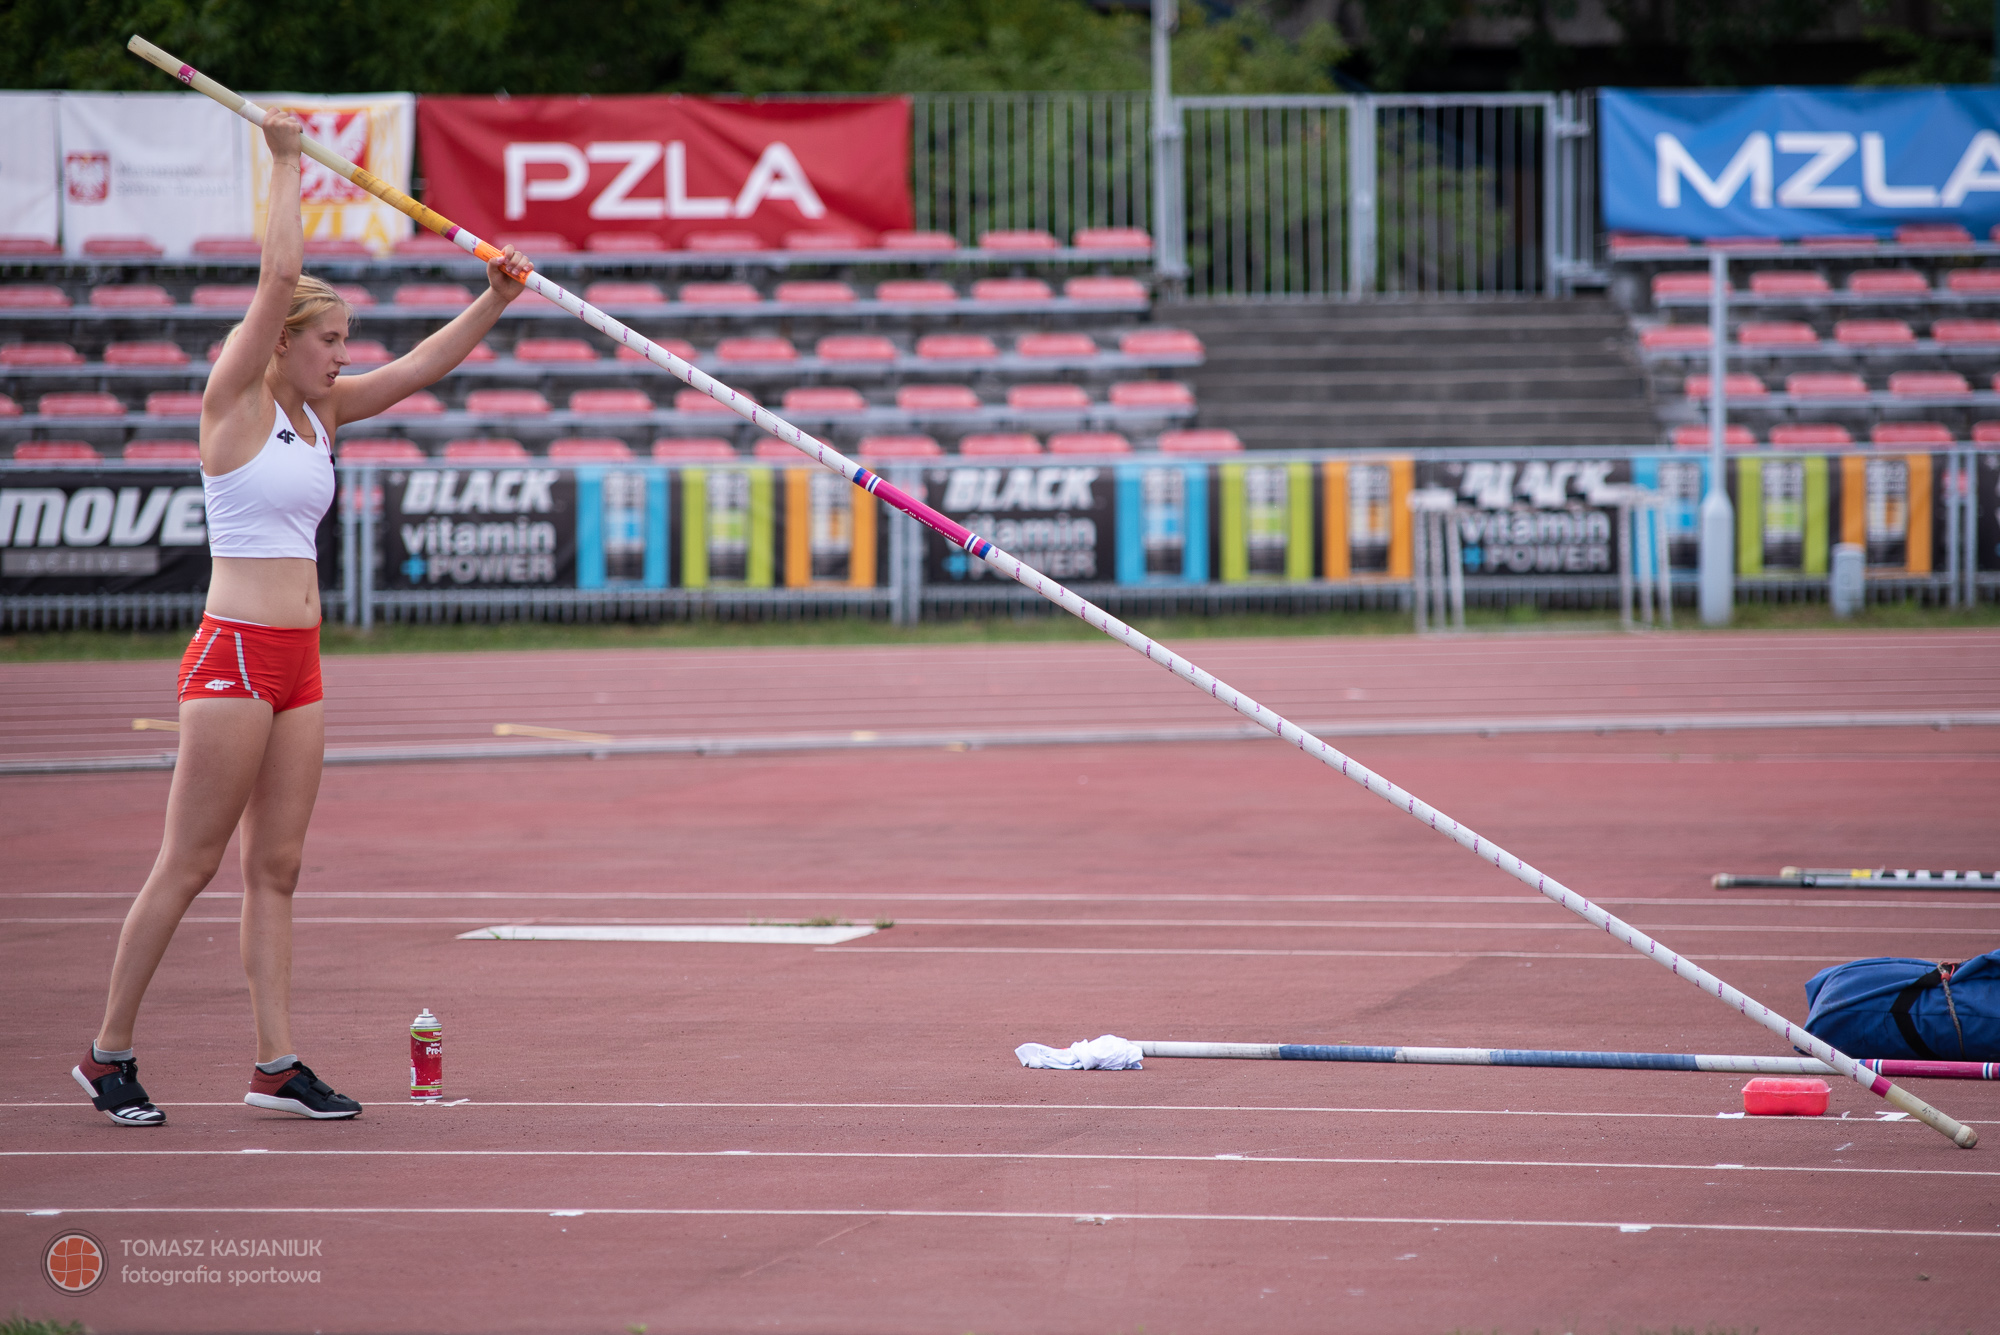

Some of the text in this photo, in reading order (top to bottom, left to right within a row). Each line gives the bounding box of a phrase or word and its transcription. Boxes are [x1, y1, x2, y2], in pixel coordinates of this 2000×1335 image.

[503, 140, 825, 221] PZLA
[1655, 130, 2000, 209] MZLA
[276, 428, 296, 445] 4F
[402, 468, 560, 514] BLACK
[942, 467, 1099, 513] BLACK
[1460, 459, 1615, 508] BLACK
[0, 485, 207, 547] MOVE
[402, 516, 557, 556] vitamin
[1460, 505, 1612, 546] vitamin
[204, 678, 236, 691] 4F
